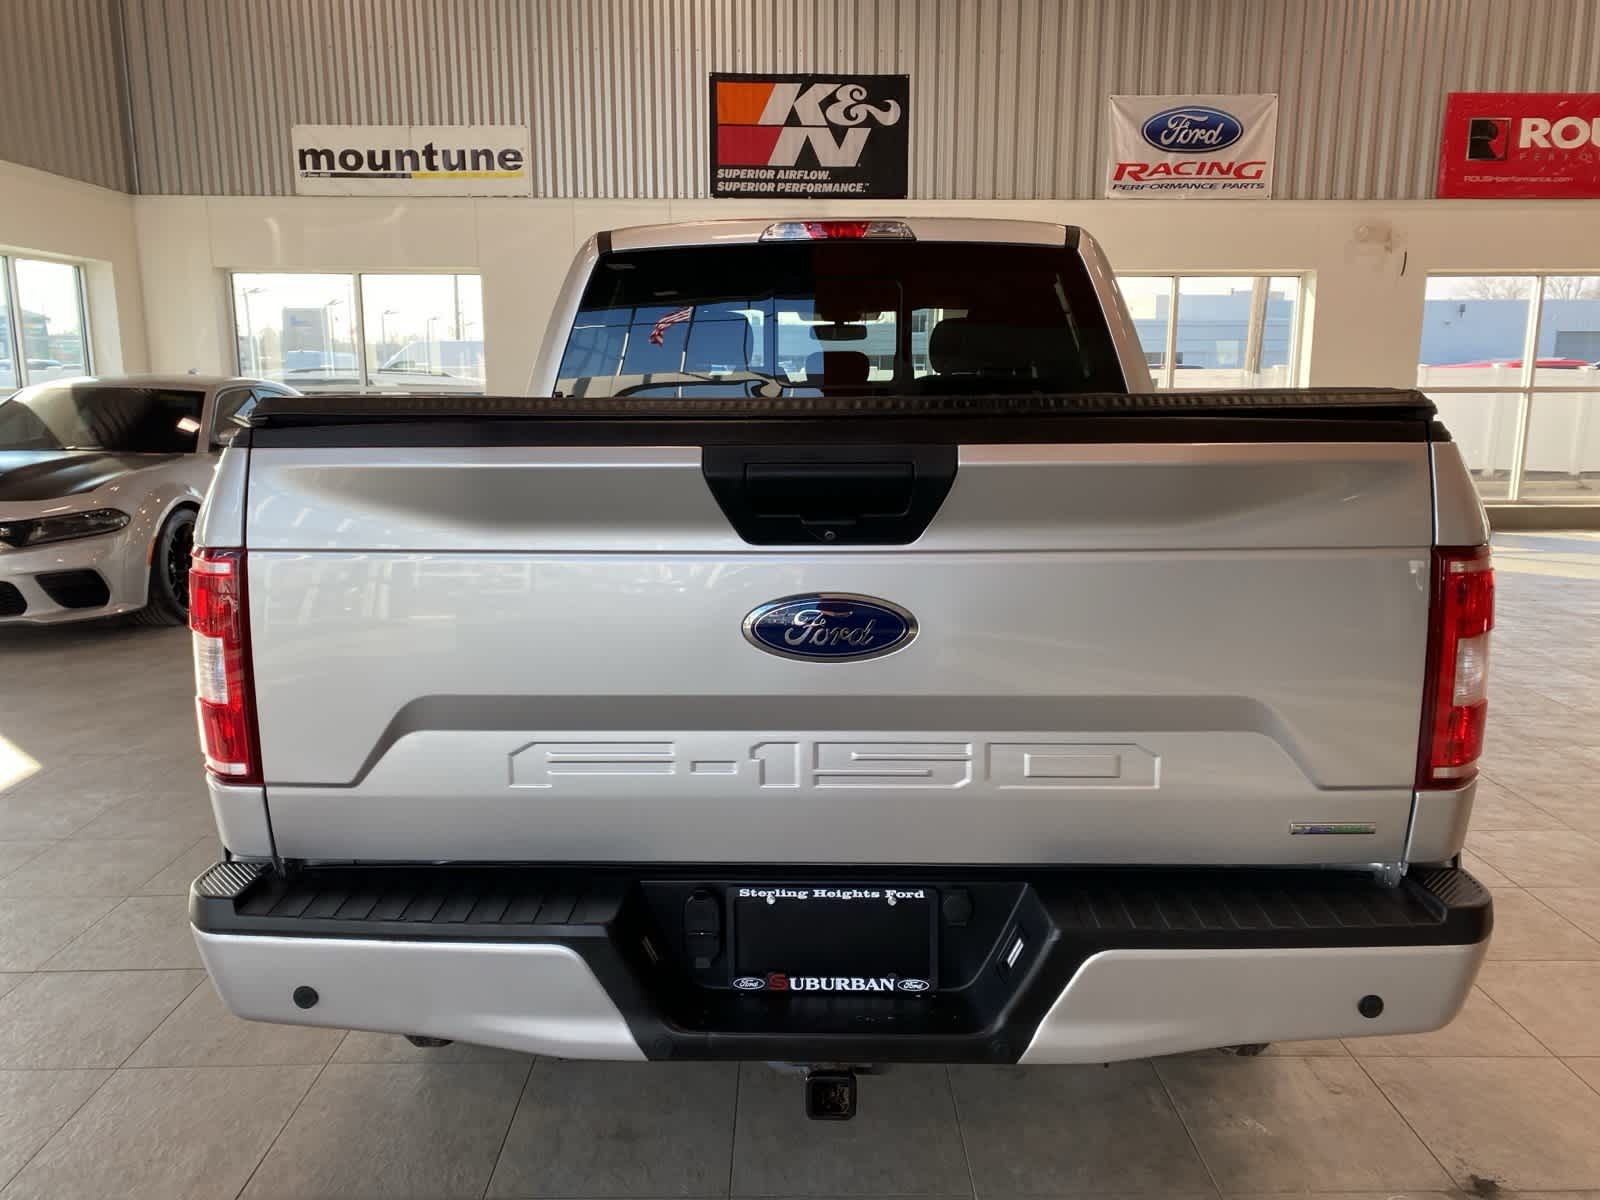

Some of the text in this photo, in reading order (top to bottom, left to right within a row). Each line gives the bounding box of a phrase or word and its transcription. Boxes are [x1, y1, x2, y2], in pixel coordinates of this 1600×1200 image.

[1160, 113, 1225, 145] Ford
[298, 142, 524, 171] mountune
[716, 168, 832, 180] SUPERIOR AIRFLOW.
[1113, 161, 1267, 182] RACING
[716, 181, 775, 193] SUPERIOR
[1112, 182, 1265, 191] PERFORMANCE PARTS
[784, 609, 877, 646] Ford
[508, 742, 1162, 790] F-150
[739, 888, 925, 899] Sterling Heights Ford
[768, 973, 895, 991] SUBURBAN
